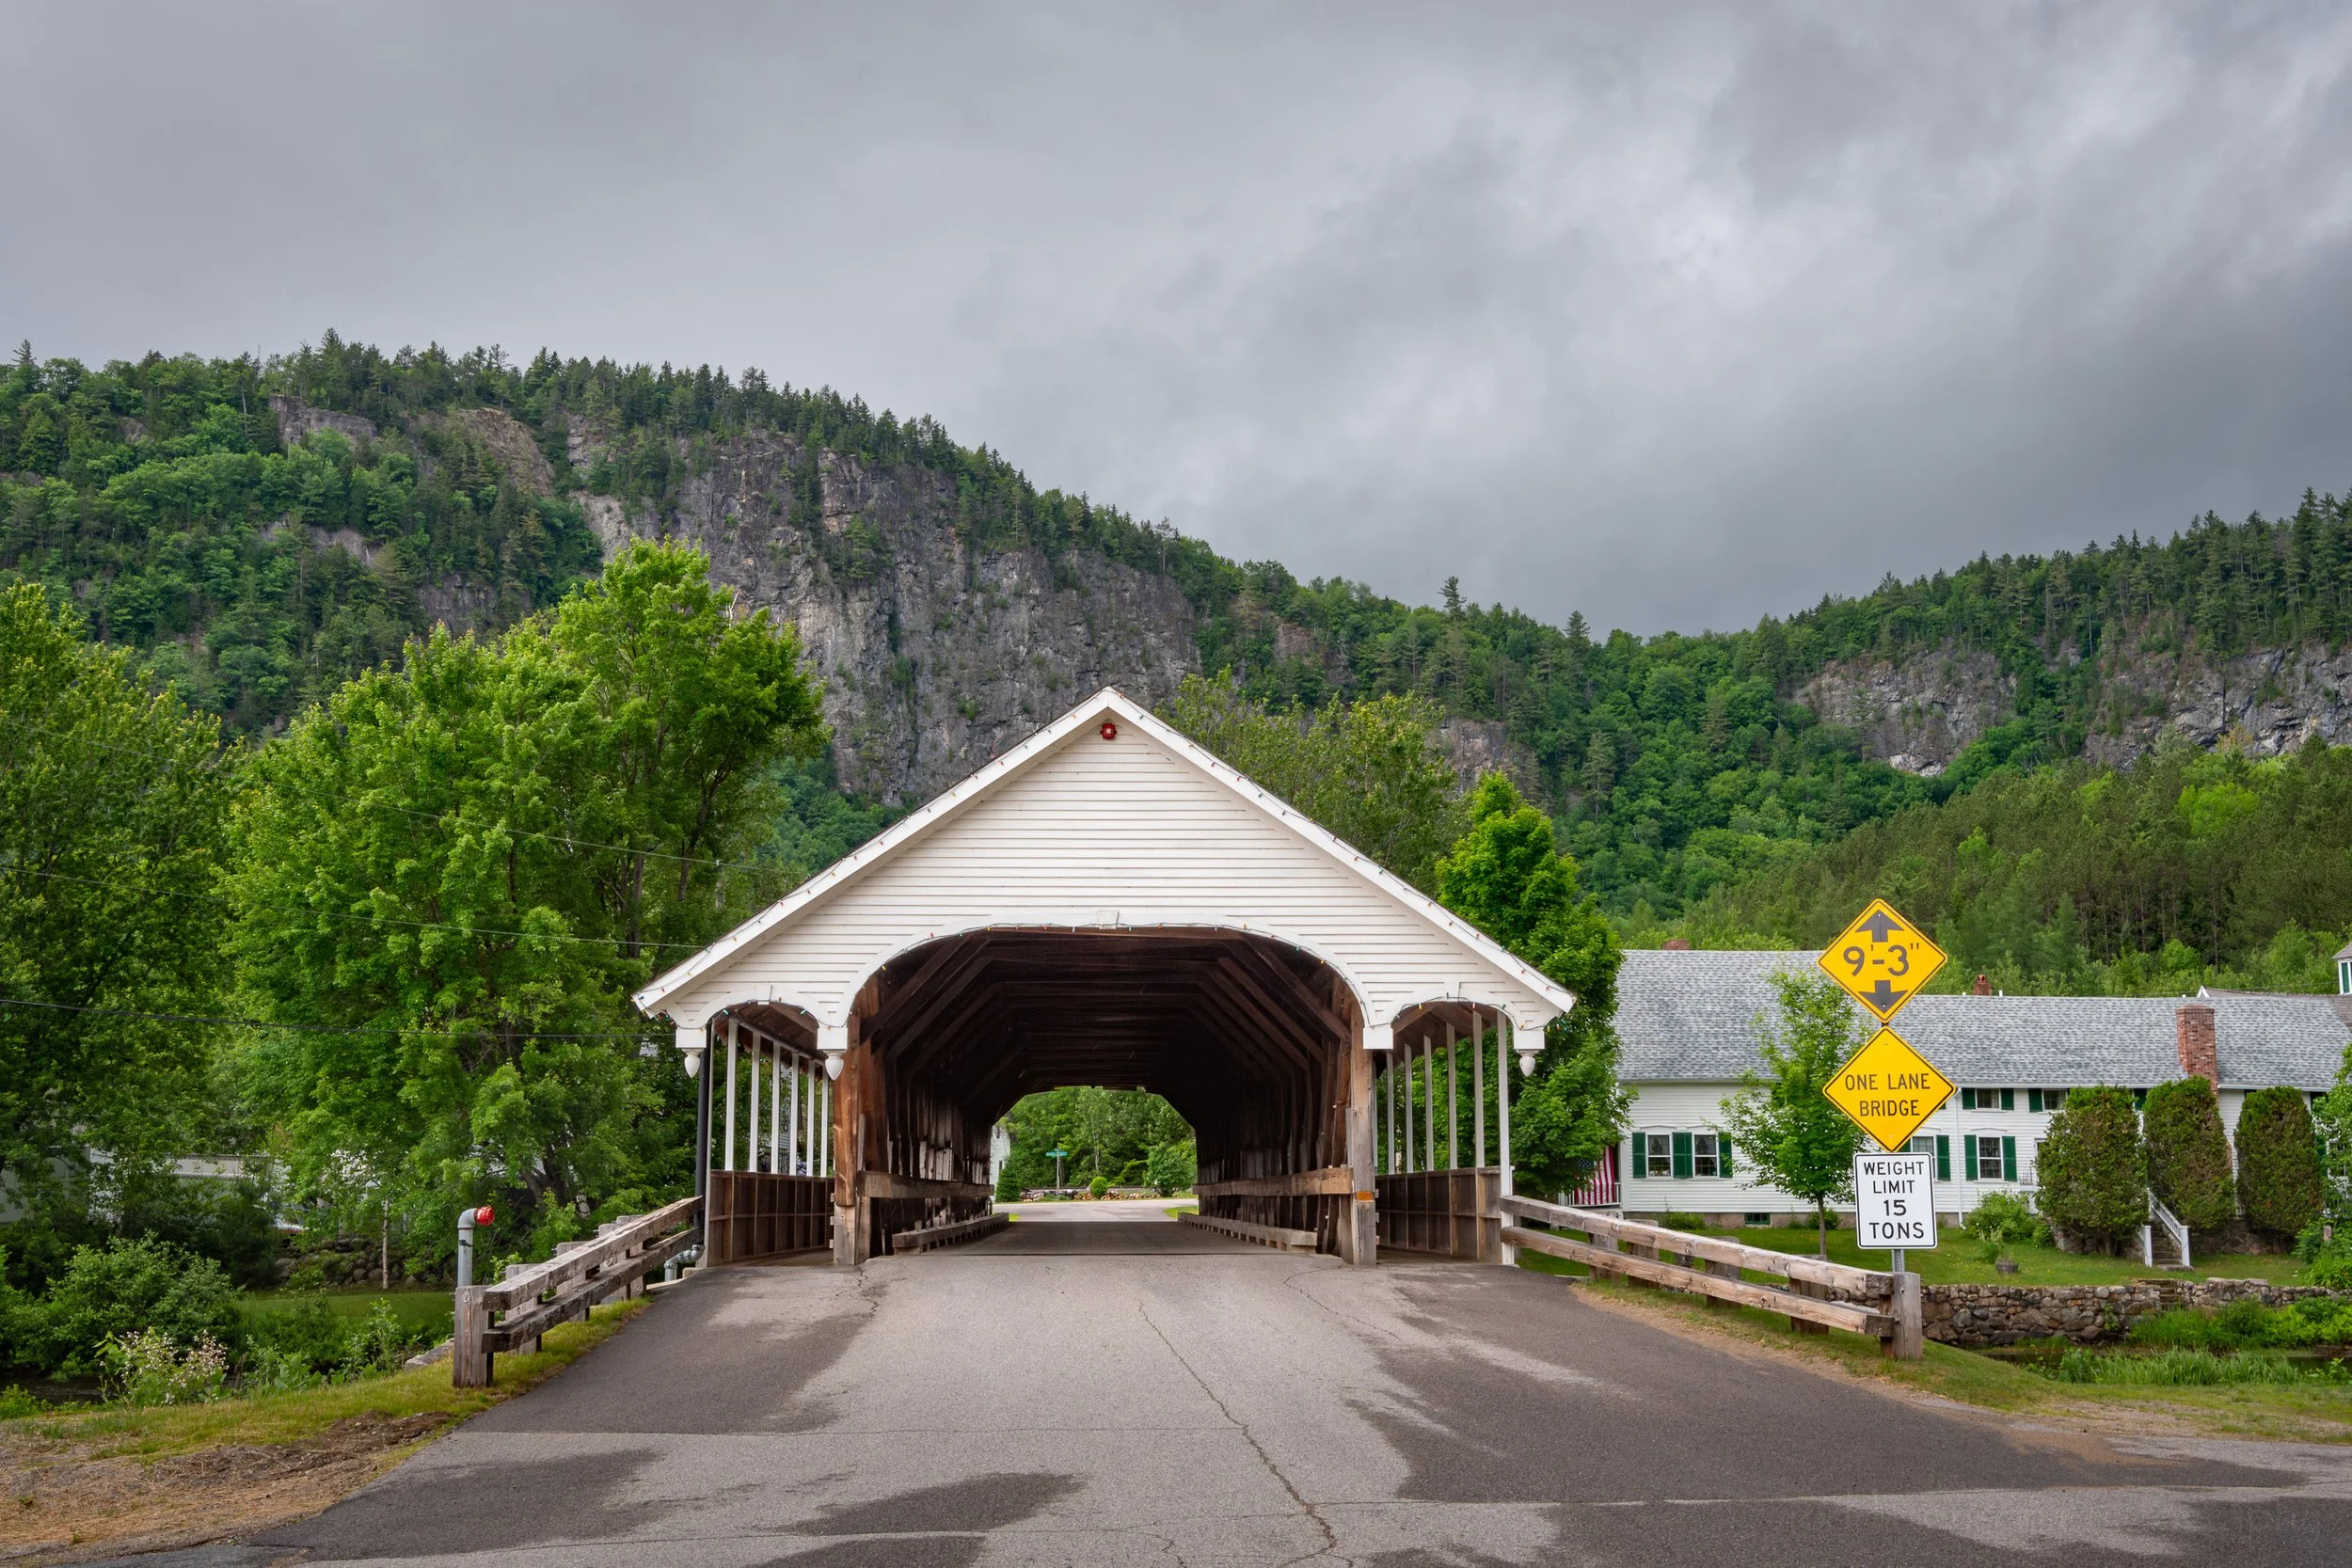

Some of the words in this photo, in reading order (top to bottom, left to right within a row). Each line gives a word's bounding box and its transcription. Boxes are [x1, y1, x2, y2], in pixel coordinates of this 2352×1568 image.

[1845, 1074, 1879, 1091] ONE
[1887, 1073, 1931, 1090] LANE
[1859, 1100, 1920, 1117] BRIDGE
[1864, 1162, 1925, 1176] WEIGHT
[1873, 1180, 1915, 1194] LIMIT
[1883, 1199, 1907, 1216] 15
[1869, 1222, 1925, 1240] TONS
